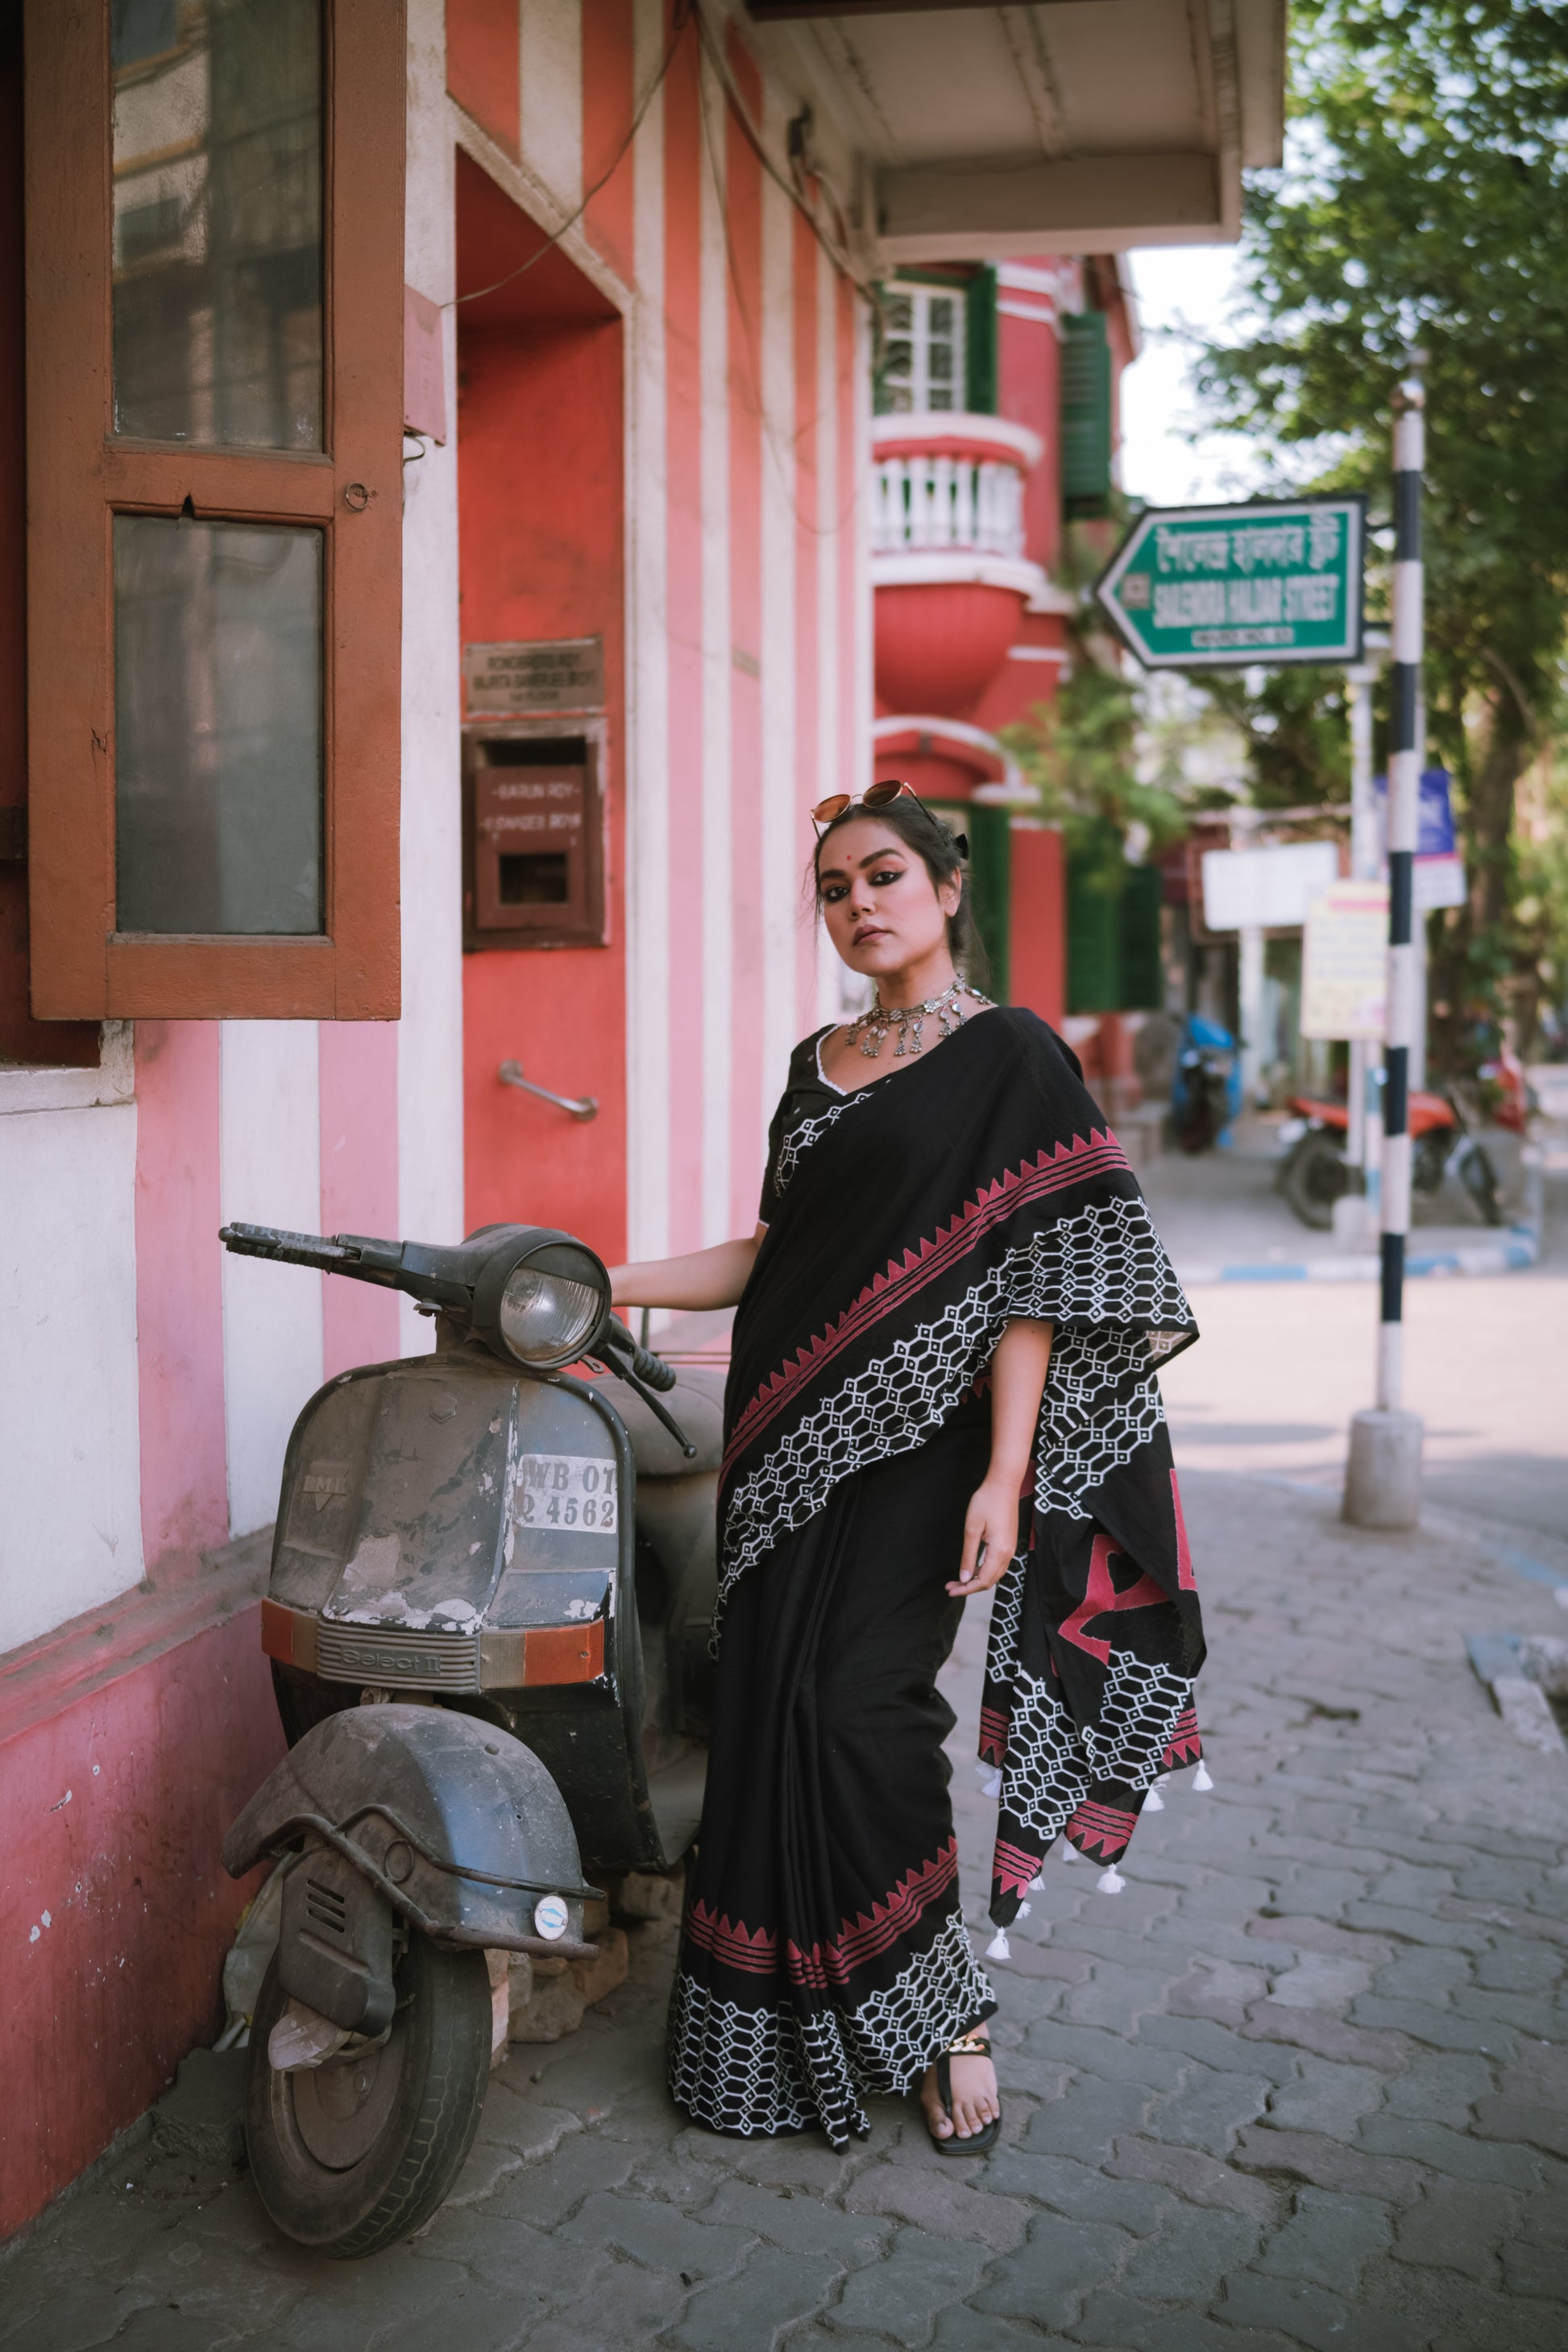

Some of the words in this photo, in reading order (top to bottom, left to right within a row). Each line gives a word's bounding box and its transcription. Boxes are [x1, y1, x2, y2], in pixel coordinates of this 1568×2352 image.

[524, 1462, 570, 1491] WB
[583, 1465, 616, 1495] 01
[546, 1496, 615, 1528] 4562
[342, 1649, 420, 1671] Select
